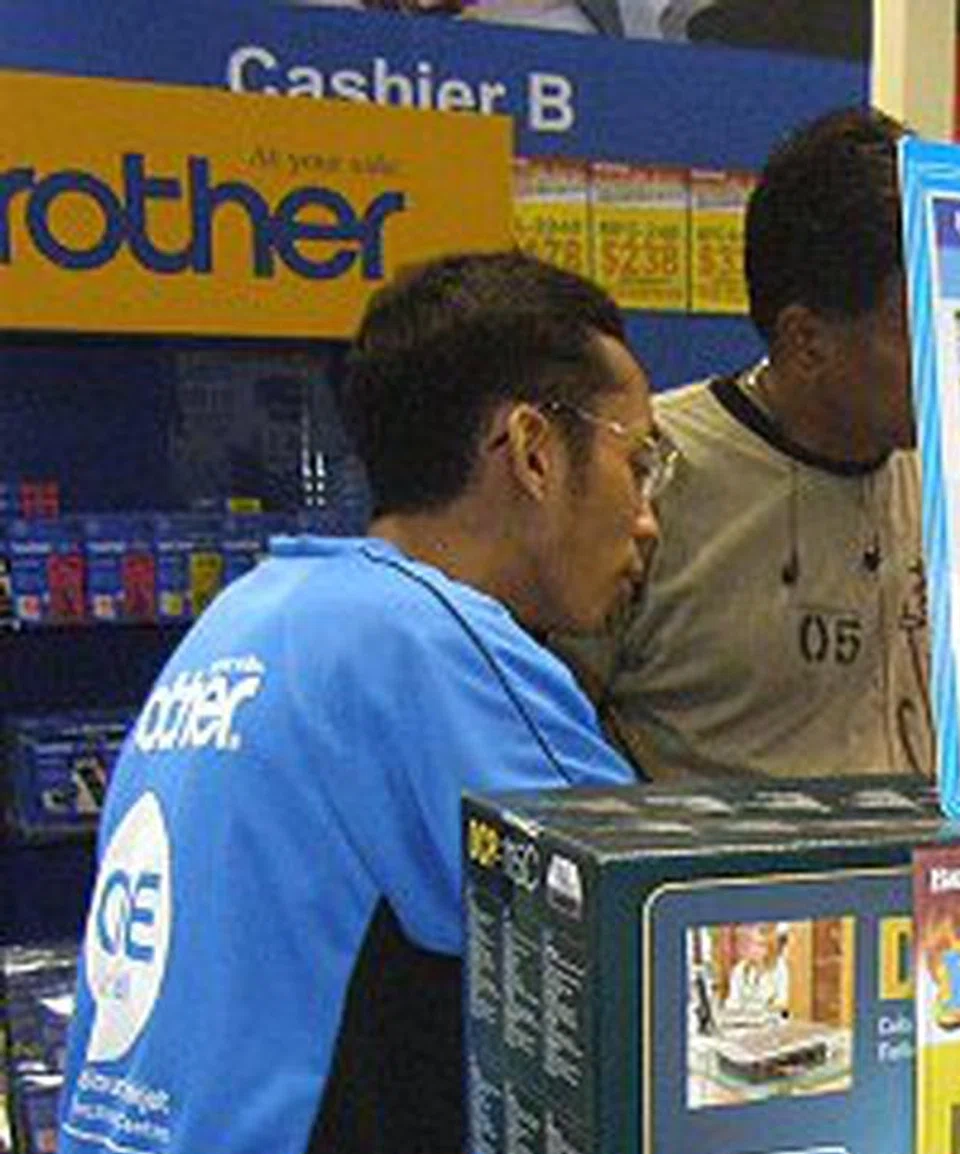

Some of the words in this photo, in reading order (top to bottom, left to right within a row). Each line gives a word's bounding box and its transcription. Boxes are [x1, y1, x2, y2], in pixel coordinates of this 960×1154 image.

[228, 47, 506, 116] Cashier
[528, 71, 575, 132] B
[800, 614, 861, 664] 05
